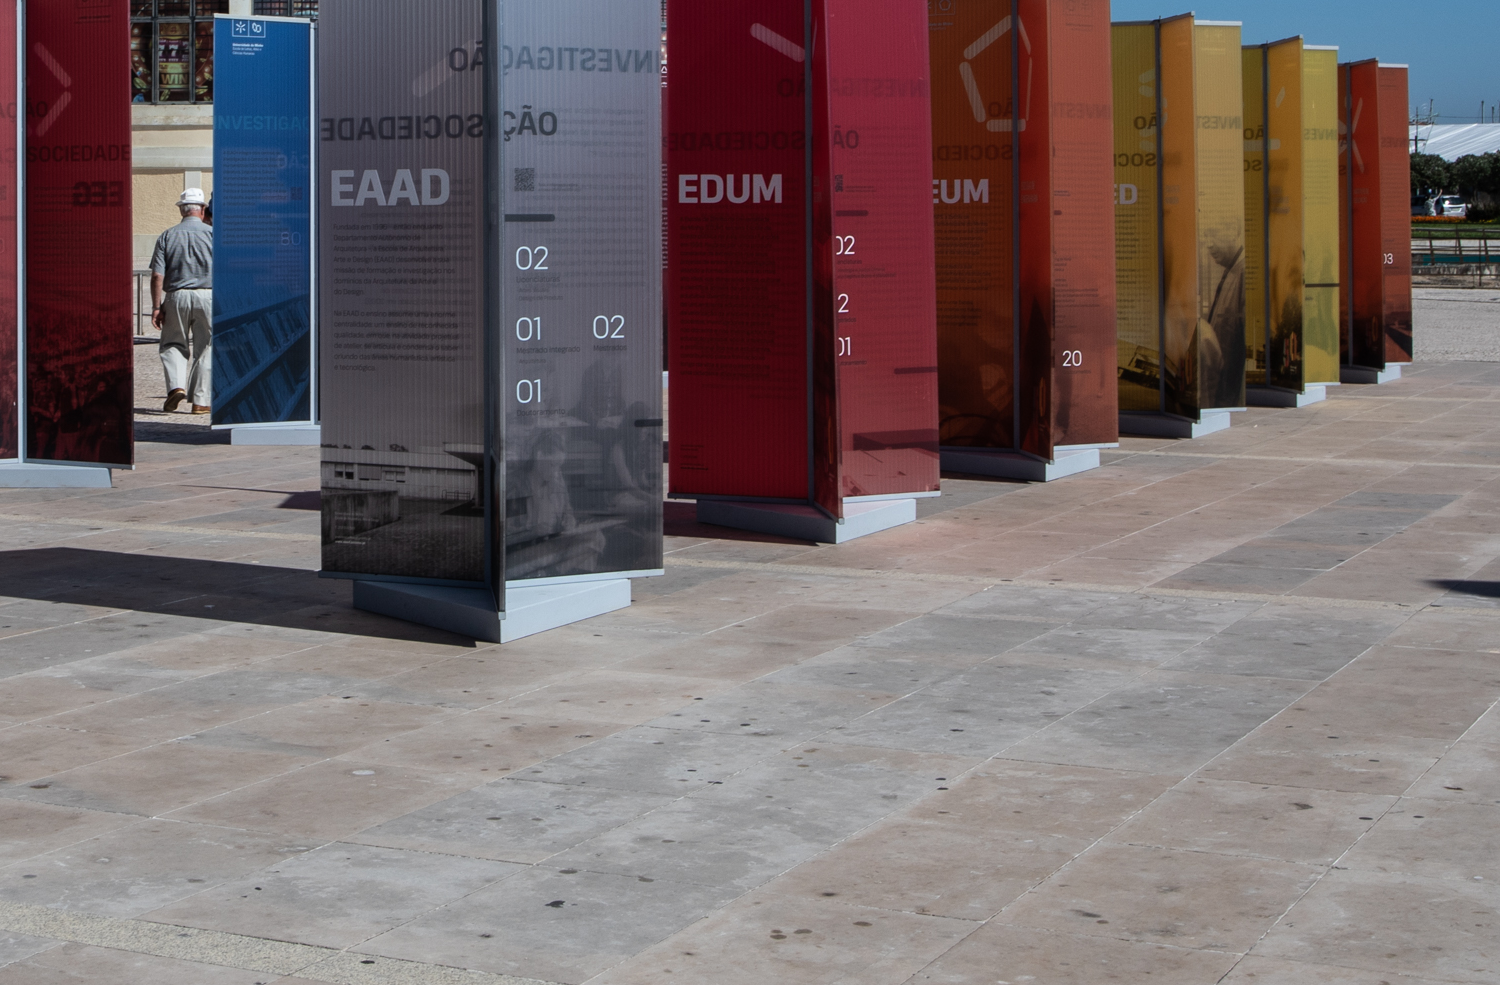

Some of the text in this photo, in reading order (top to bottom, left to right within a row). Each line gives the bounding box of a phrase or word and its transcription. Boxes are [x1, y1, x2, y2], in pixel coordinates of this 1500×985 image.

[161, 73, 188, 85] WIN
[213, 116, 309, 131] INVESTIGA
[26, 145, 131, 163] SOCIEDADE
[331, 168, 450, 206] EAAD
[678, 174, 782, 204] EDUM
[516, 246, 549, 270] 02
[516, 315, 625, 341] 01 02
[1062, 350, 1082, 367] 20
[516, 379, 541, 404] 01
